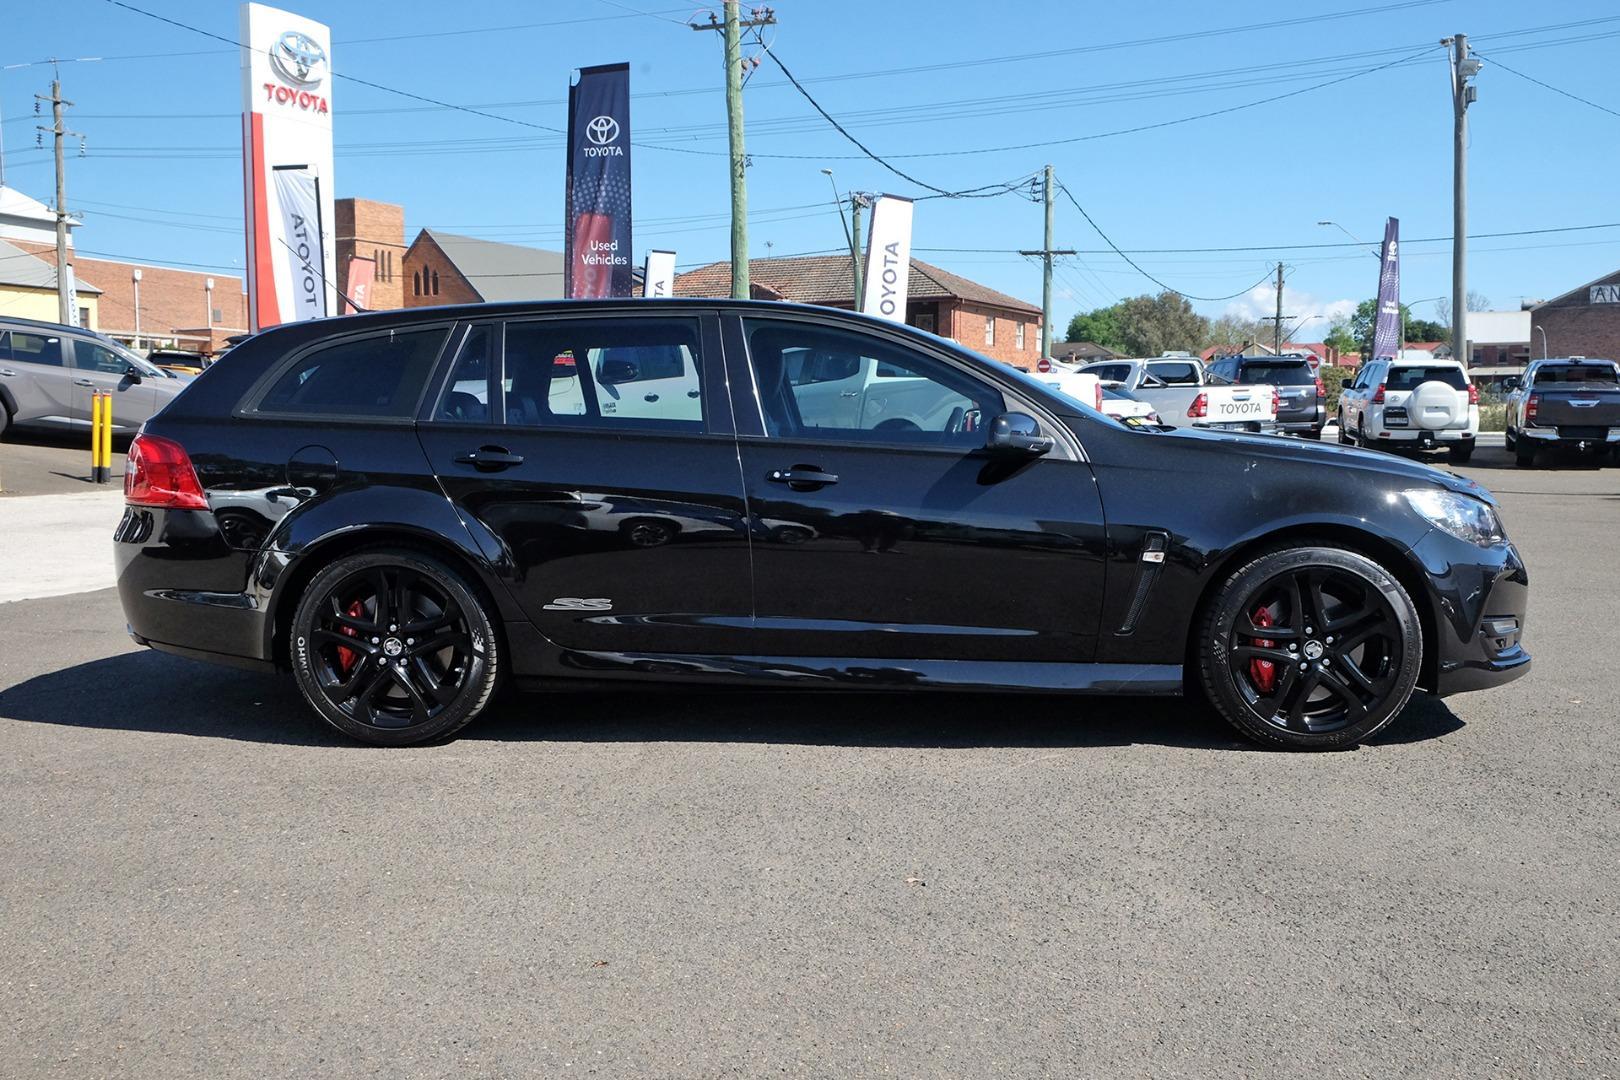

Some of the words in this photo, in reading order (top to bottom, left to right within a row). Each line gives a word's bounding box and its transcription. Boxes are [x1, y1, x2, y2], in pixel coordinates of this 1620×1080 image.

[263, 83, 329, 115] TOYOTA
[583, 146, 623, 157] TOYOTA
[590, 240, 618, 251] Used
[581, 254, 628, 265] Vehicles
[880, 241, 899, 316] OYOTA
[1219, 403, 1262, 414] TOYOTA
[542, 597, 613, 611] SS
